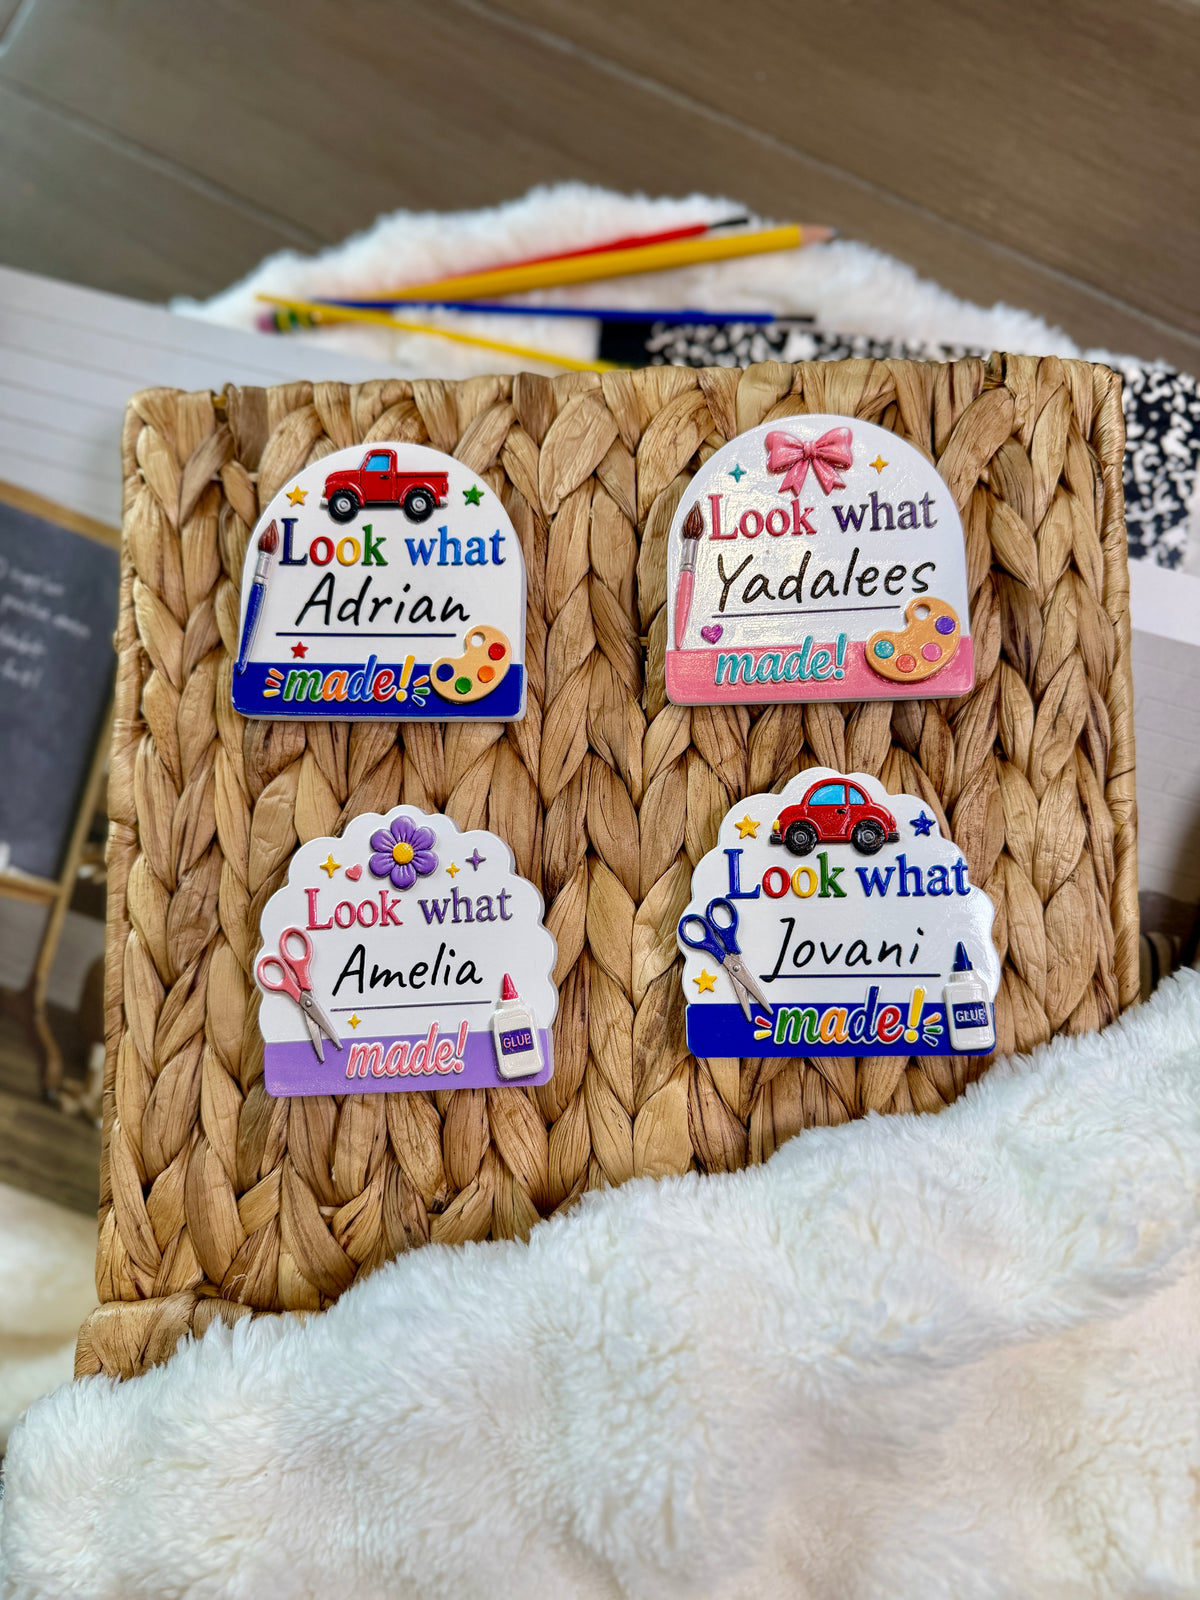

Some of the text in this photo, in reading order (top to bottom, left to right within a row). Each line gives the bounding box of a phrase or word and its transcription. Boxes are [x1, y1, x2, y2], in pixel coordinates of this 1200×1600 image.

[708, 491, 937, 540] Look what
[279, 518, 506, 566] Look what
[295, 572, 470, 626] Adrian
[717, 547, 936, 613] Yadalees
[283, 654, 415, 701] made!
[714, 633, 847, 685] made!
[723, 849, 971, 899] Look what
[304, 886, 513, 931] Look what
[332, 942, 483, 996] Amelia
[759, 917, 925, 983] Jovani
[773, 985, 927, 1045] made!
[955, 1010, 987, 1025] GLUE
[346, 1020, 469, 1080] made!
[502, 1033, 532, 1049] GLUE
